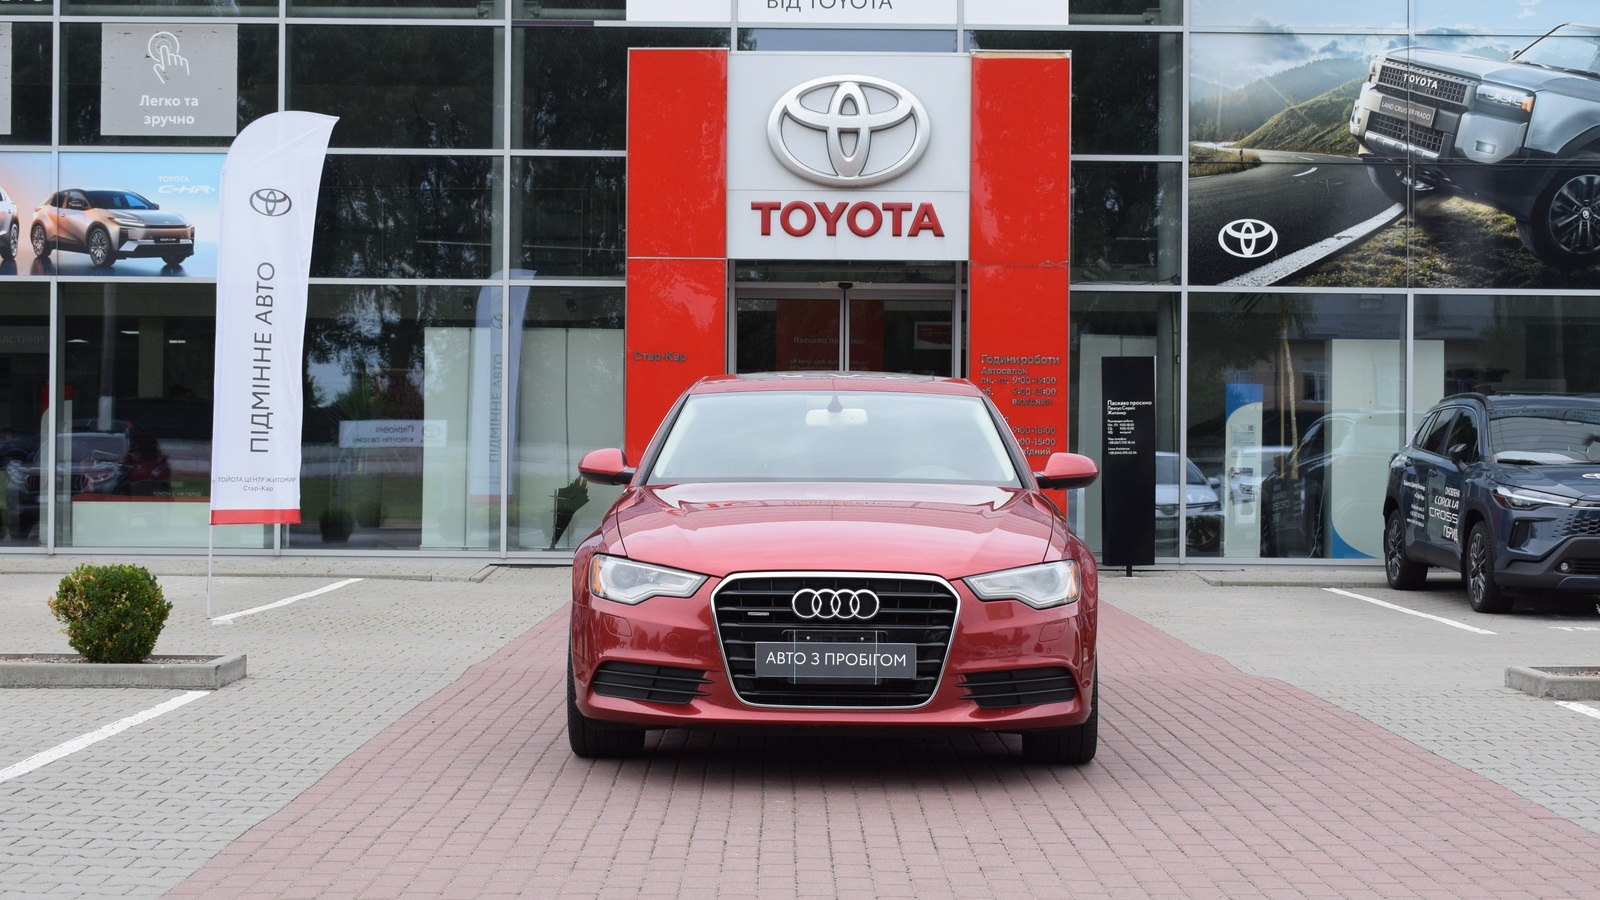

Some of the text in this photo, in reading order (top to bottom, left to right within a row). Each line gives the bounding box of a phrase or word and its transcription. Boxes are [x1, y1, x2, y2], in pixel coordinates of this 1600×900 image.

[1403, 74, 1438, 89] TOYOTA
[139, 95, 199, 106] Легко та
[1382, 101, 1394, 110] LAND
[1414, 110, 1431, 121] PRADO
[144, 116, 195, 128] зручно
[750, 200, 946, 238] TOYOTA
[250, 262, 275, 452] ПІДМІННЕ АВТО
[634, 350, 687, 363] Стар-Кар
[981, 354, 1060, 366] Години роботи
[981, 366, 1028, 374] Автосалон
[1012, 398, 1052, 406] вихідний
[1022, 447, 1051, 456] хідний
[1434, 495, 1459, 509] COROLLA
[1428, 507, 1458, 524] CROSS
[766, 651, 906, 667] АВТО З ПРОБІГОМ
